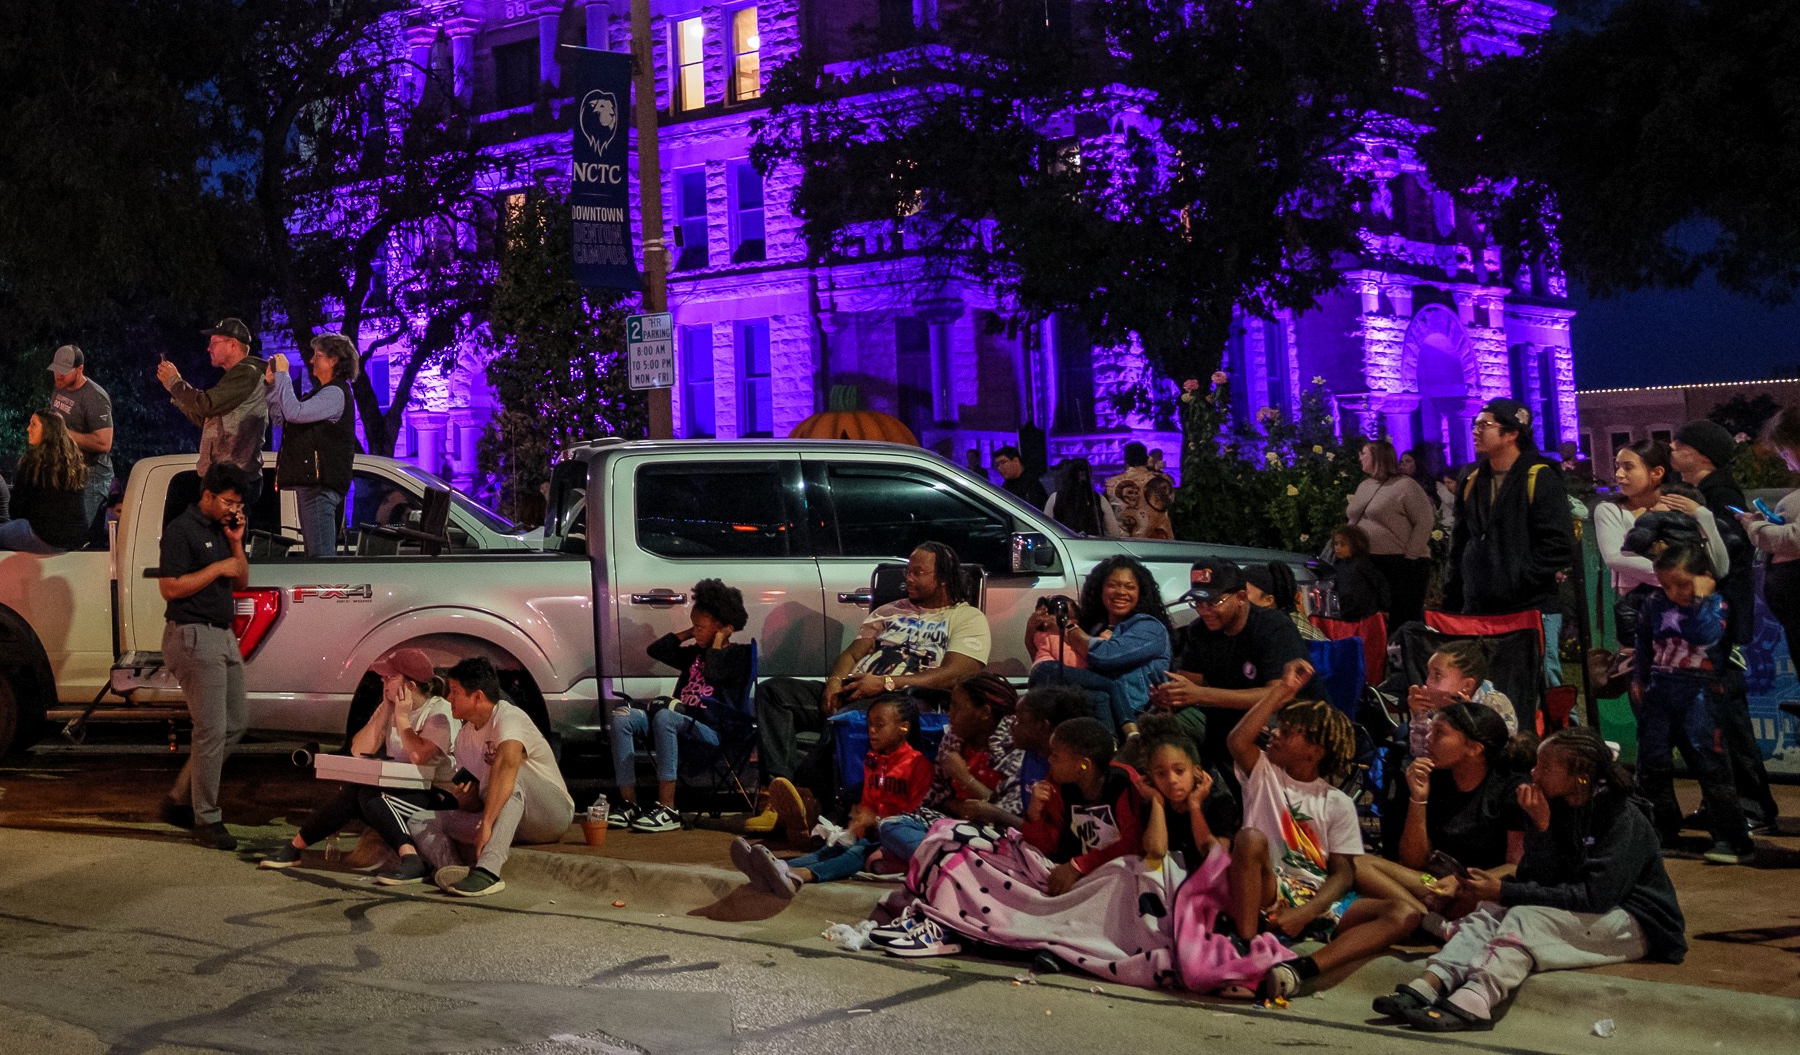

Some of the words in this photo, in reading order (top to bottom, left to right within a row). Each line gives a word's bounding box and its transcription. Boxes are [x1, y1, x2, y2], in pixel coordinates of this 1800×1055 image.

[573, 162, 622, 184] NCTC
[572, 205, 624, 222] DOWNTOWN
[573, 222, 623, 244] DENTON
[573, 243, 628, 265] CAMPUS
[631, 321, 641, 340] 2
[643, 329, 671, 340] PARKING
[655, 345, 665, 355] AM
[632, 361, 640, 371] TO
[643, 360, 659, 370] 5:00
[662, 358, 671, 368] PM
[635, 374, 650, 384] MON
[657, 372, 669, 382] FRI
[292, 583, 372, 603] FX4
